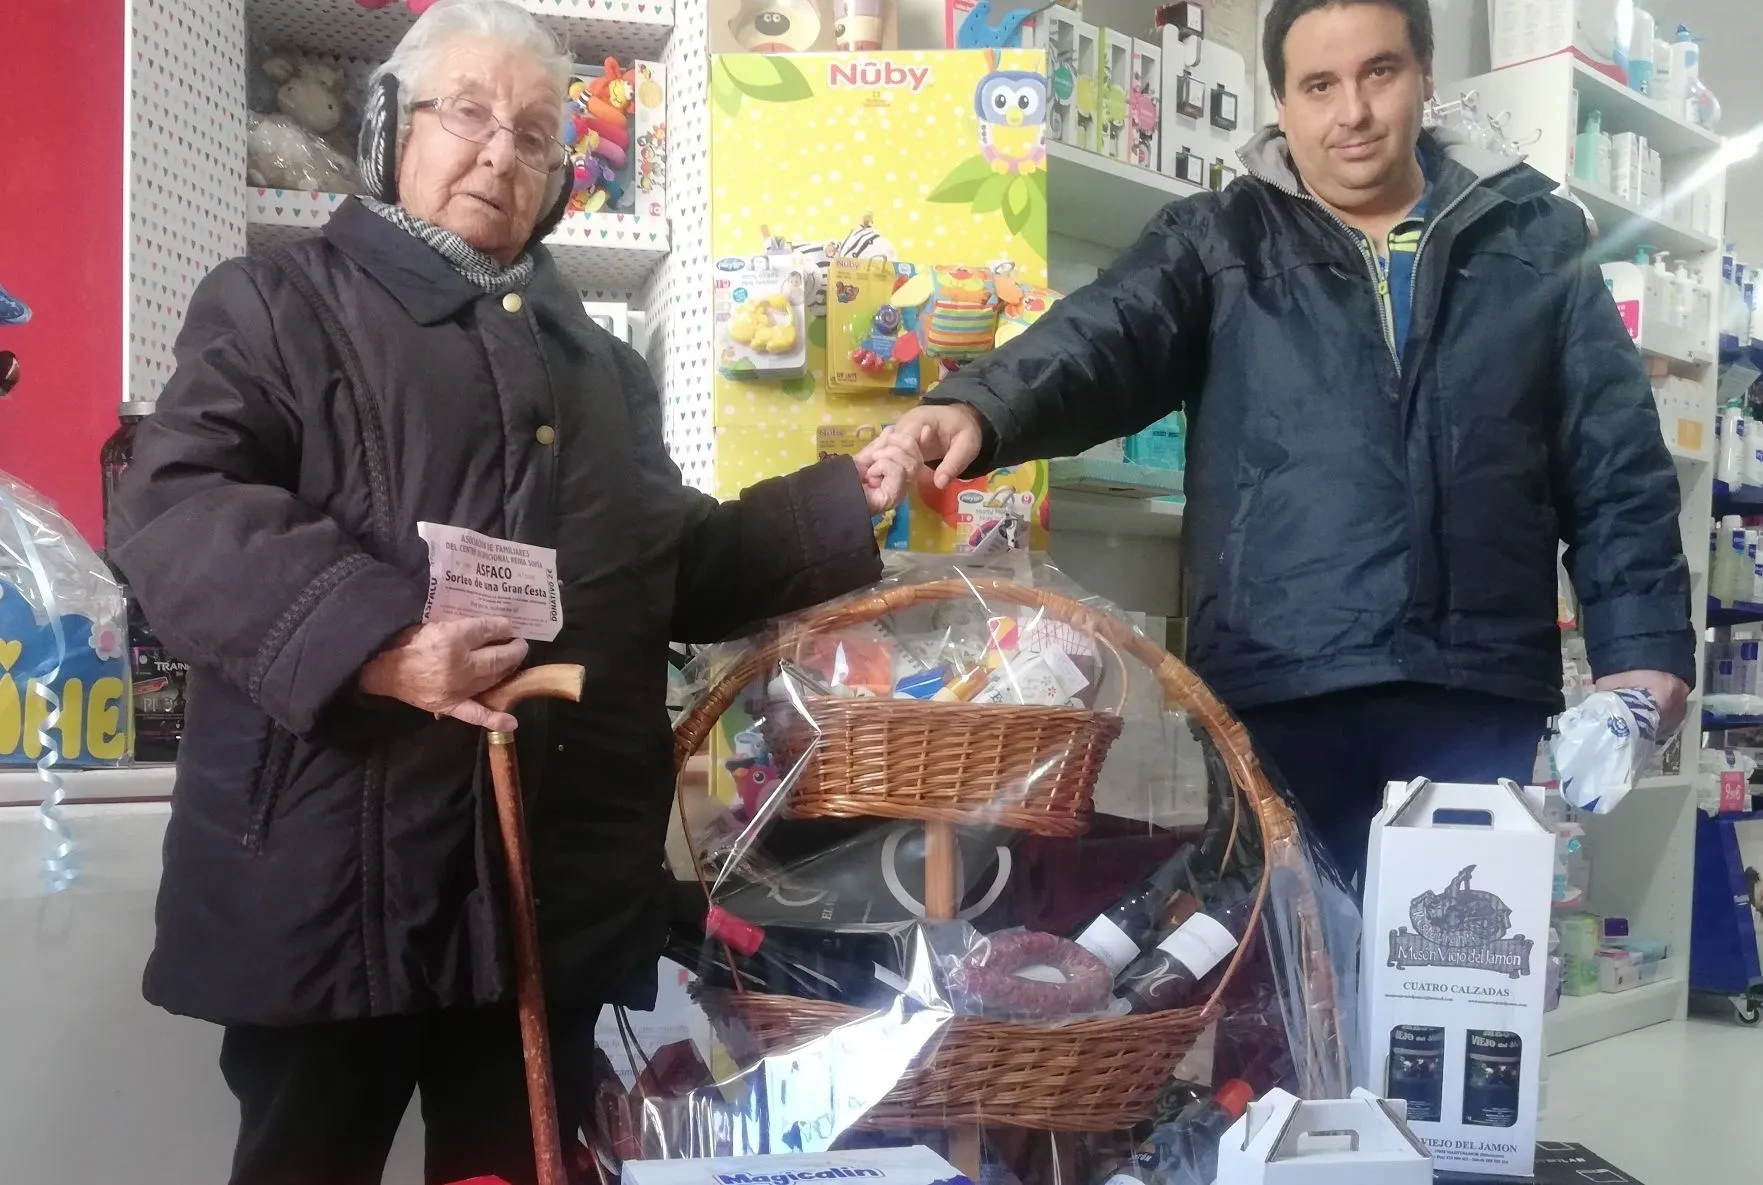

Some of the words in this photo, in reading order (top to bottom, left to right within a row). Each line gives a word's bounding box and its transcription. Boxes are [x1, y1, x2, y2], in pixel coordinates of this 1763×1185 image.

[445, 542, 458, 551] DEL
[495, 544, 530, 557] FAMILIARES
[476, 562, 512, 580] ASFACO
[445, 570, 473, 586] Sorteo
[474, 577, 483, 588] de
[484, 581, 499, 592] una
[501, 582, 523, 596] Gran
[524, 585, 547, 598] Cesta
[1438, 948, 1466, 963] Viejo
[1468, 949, 1484, 963] del
[1483, 951, 1521, 966] Jamón
[1403, 981, 1448, 993] CUATRO
[1450, 984, 1510, 997] CALZADAS
[1472, 1035, 1496, 1048] VIEJO
[1420, 1137, 1453, 1148] VIEJO
[1455, 1140, 1477, 1150] DEL
[1478, 1142, 1518, 1153] JAMON
[718, 1166, 880, 1185] Magicalin
